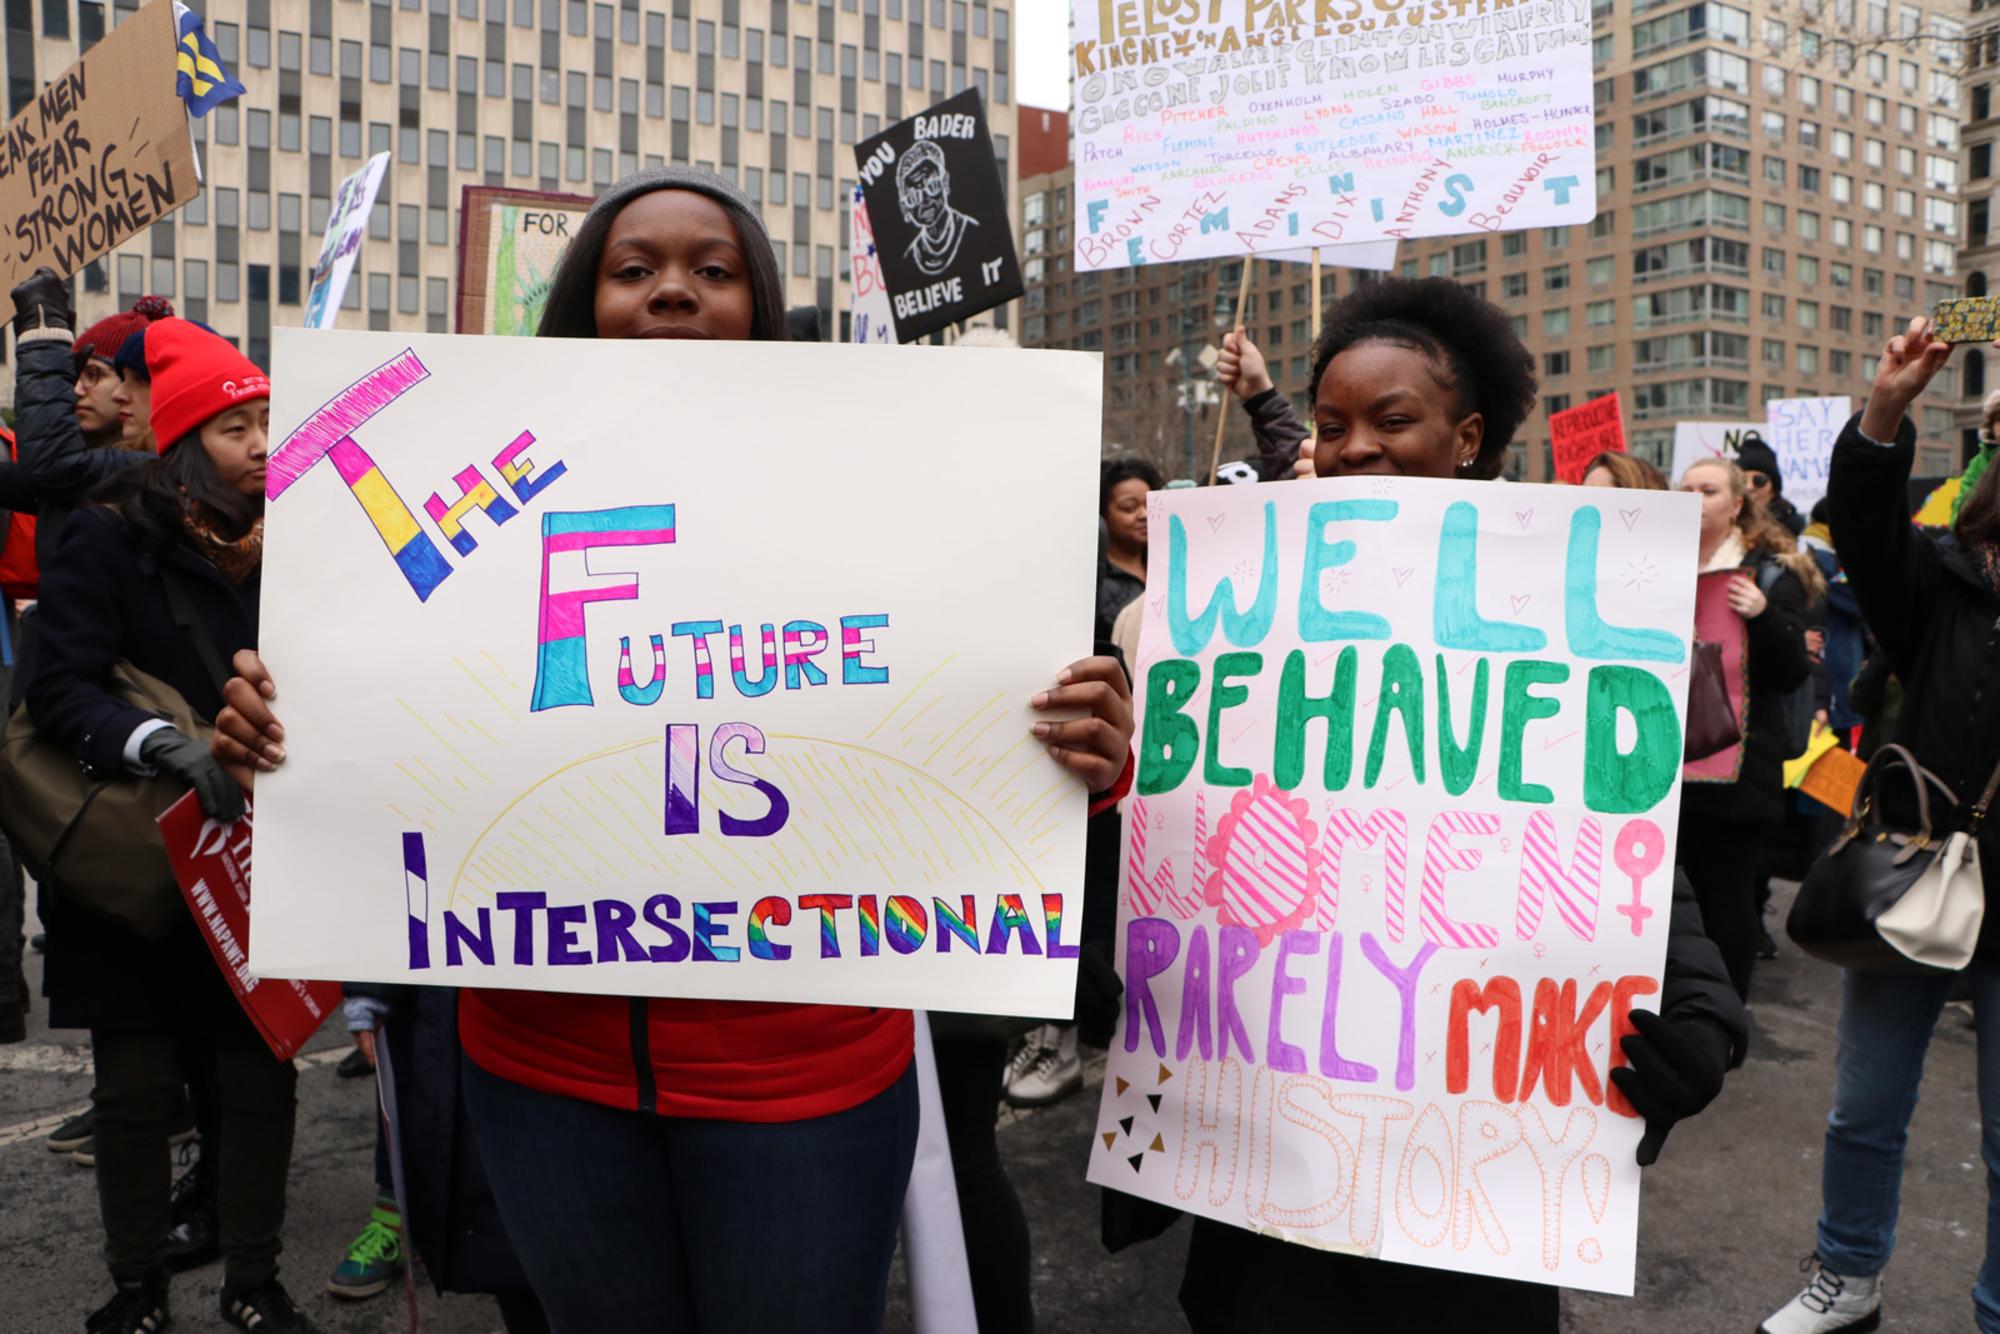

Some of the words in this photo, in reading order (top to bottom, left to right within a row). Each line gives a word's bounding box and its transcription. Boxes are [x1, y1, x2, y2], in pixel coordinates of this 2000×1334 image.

[1075, 37, 1138, 78] KING
[1217, 18, 1376, 53] ANGELOU
[1081, 66, 1169, 104] ONO
[1172, 43, 1293, 77] WALKER
[1296, 23, 1443, 63] CLINTON
[1447, 0, 1588, 40] WINFREY
[1209, 64, 1291, 104] JOLIE
[1305, 42, 1470, 85] KNOWLES
[1473, 32, 1530, 64] GAY
[1344, 83, 1399, 100] HOLEN
[1420, 74, 1477, 92] GIBBS
[1497, 68, 1554, 85] MURPHY
[38, 61, 87, 139] MEN
[1161, 105, 1229, 126] PITCHER
[1248, 94, 1323, 113] OXENHOLM
[1303, 103, 1354, 121] LYONS
[1338, 109, 1406, 130] CASSANO
[1381, 93, 1436, 110] SZABO
[1421, 104, 1460, 119] HALL
[859, 141, 896, 186] YOU
[914, 113, 976, 140] BADER
[1083, 141, 1123, 163] PATCH
[1123, 122, 1163, 144] RICH
[1162, 136, 1216, 154] FLEMING
[1236, 124, 1319, 144] HUTCHINGS
[1294, 132, 1379, 154] RUTLEDGE
[1328, 140, 1414, 160] ALBAHARY
[1428, 127, 1522, 148] MARTINEZ
[1520, 137, 1587, 154] POLLOCK
[27, 119, 91, 197] FEAR
[1129, 158, 1182, 174] WATSON
[1252, 154, 1311, 171] CREWS
[1294, 160, 1345, 178] ELLIS
[15, 143, 130, 263] STRONG
[53, 160, 176, 275] WOMEN
[1235, 182, 1308, 250] ADAMS
[1312, 194, 1358, 240] DIX
[1383, 158, 1453, 240] ANTHONY
[523, 212, 568, 237] FOR
[1078, 194, 1161, 268] BROWN
[1150, 190, 1227, 261] CORTEZ
[893, 277, 964, 319] BELIEVE
[981, 257, 1003, 286] IT
[1775, 398, 1835, 428] SAY
[1774, 428, 1834, 454] HER
[265, 347, 568, 603] THE
[1167, 498, 1685, 664] WELL
[530, 503, 889, 712] FUTURE
[1136, 643, 1683, 813] BEHAVED
[665, 723, 789, 838] IS
[1128, 774, 1603, 949] WOMEN
[402, 831, 1080, 970] INTERSECTIONAL
[190, 877, 260, 993] WWW.NAPAWF.ORG
[1123, 917, 1442, 1092] RARELY
[1445, 974, 1659, 1118] MAKE
[1174, 1055, 1612, 1271] HISTORY!
